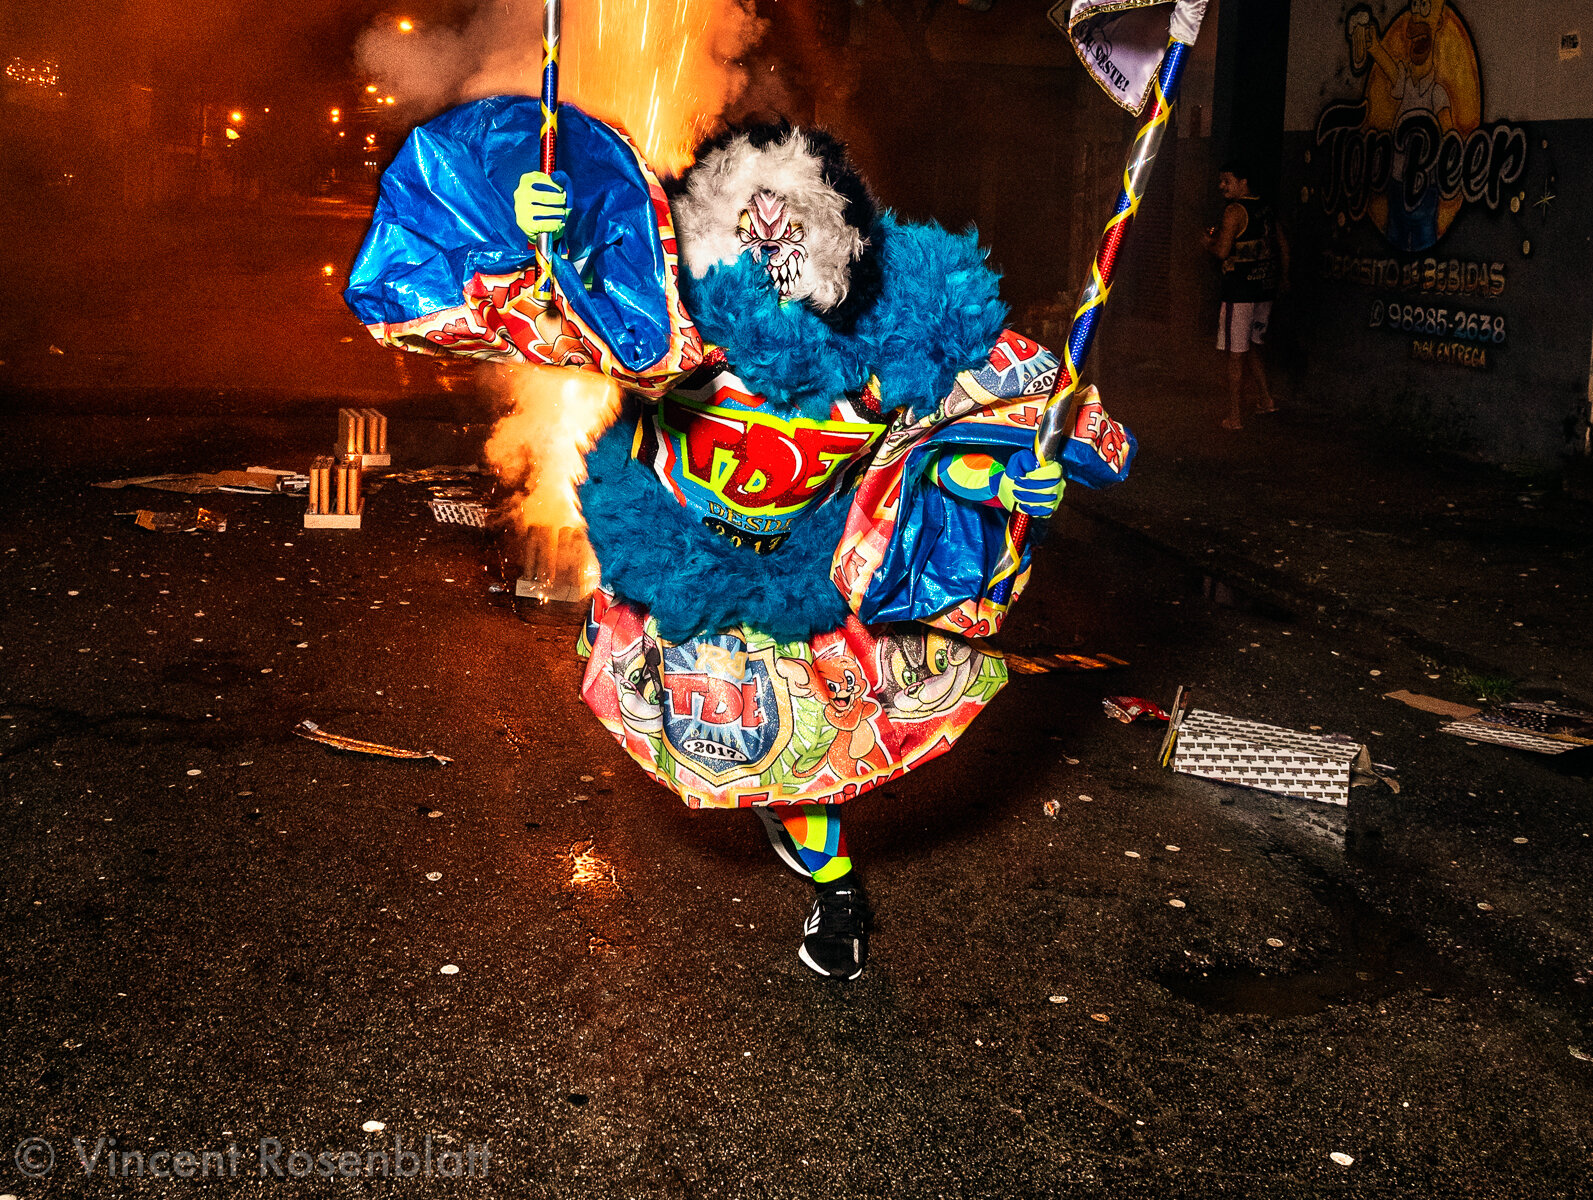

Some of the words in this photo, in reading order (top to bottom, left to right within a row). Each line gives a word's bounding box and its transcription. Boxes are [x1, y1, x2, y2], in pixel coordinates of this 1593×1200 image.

[1422, 257, 1506, 296] BEBIDAS
[1387, 303, 1506, 344] 98285-2638
[694, 741, 737, 759] 2017
